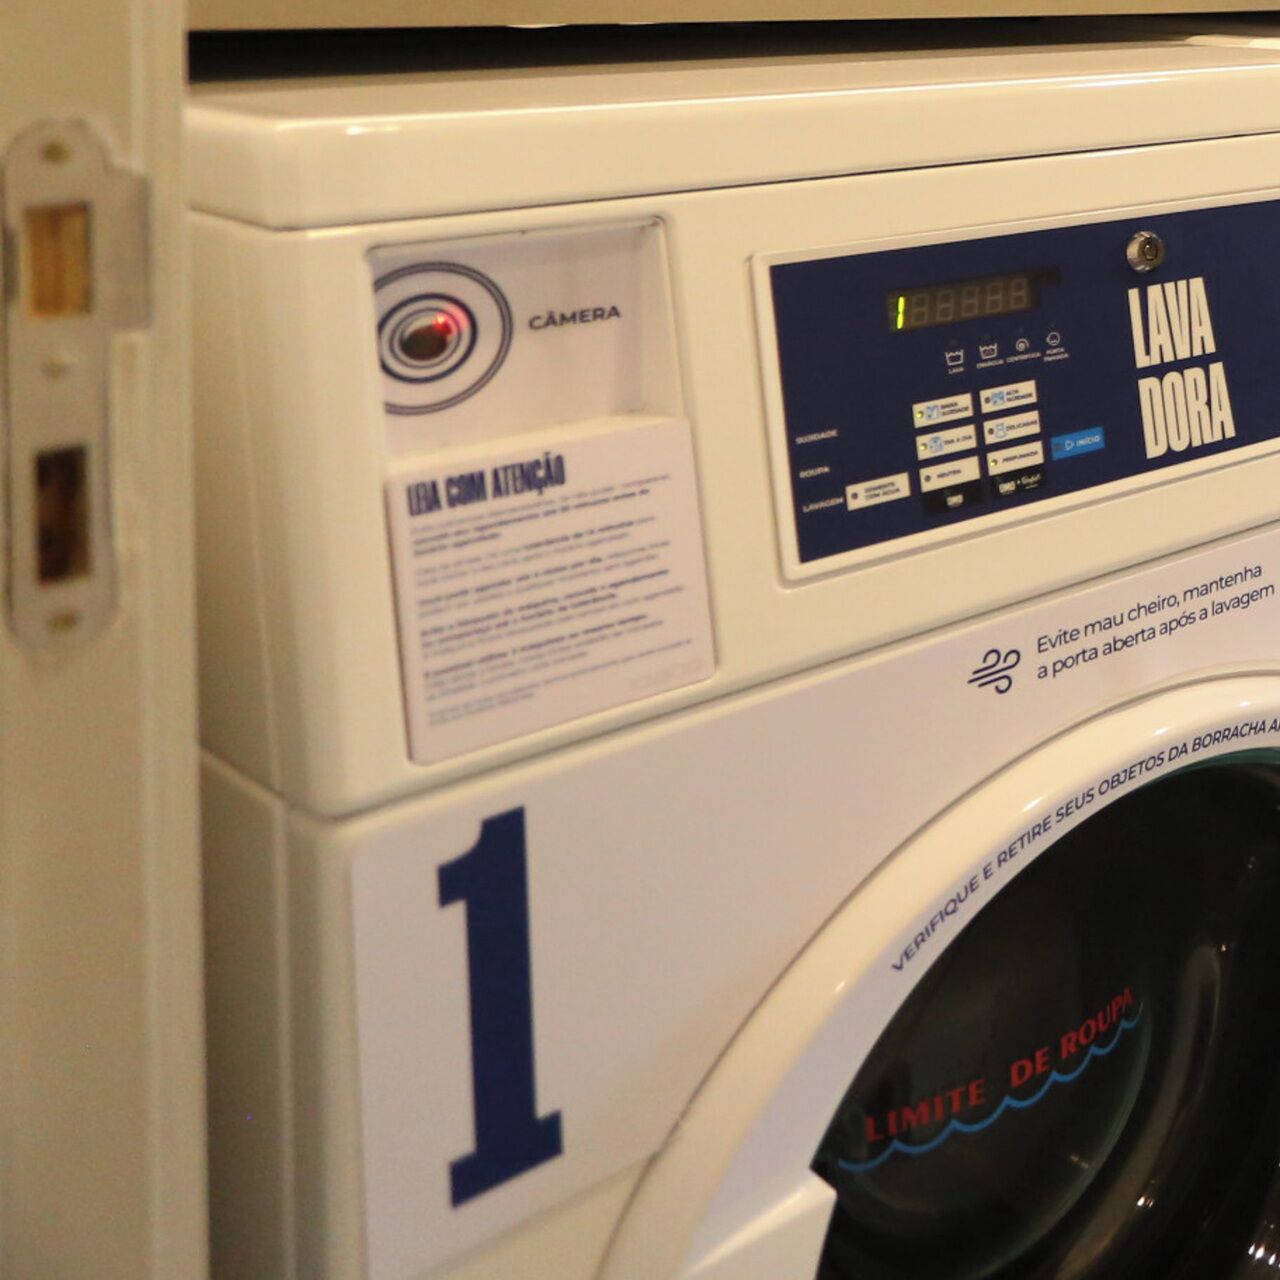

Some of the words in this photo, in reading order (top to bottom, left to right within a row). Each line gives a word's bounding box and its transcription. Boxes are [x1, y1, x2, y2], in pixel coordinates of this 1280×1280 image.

[529, 306, 621, 331] CÂMERA
[1128, 277, 1216, 369] LAVA
[1138, 362, 1236, 460] DORA
[407, 480, 441, 517] LEIA
[446, 470, 486, 508] COM
[492, 451, 566, 498] ATENÇÃO
[1037, 628, 1080, 654] Evite
[1083, 614, 1125, 638] mau
[1128, 593, 1181, 623] cheiro,
[1183, 565, 1263, 603] mantenha
[1038, 666, 1048, 680] a
[1052, 648, 1099, 678] porta
[1102, 627, 1156, 663] aberta
[1159, 611, 1197, 638] após
[1200, 608, 1209, 622] a
[1210, 583, 1275, 618] lavagem
[891, 876, 982, 973] VERIFIQUE
[982, 863, 996, 880] E
[997, 815, 1054, 869] RETIRE
[1054, 788, 1096, 825] SEUS
[1098, 751, 1166, 797] OBJETOS
[1167, 741, 1189, 763] DA
[1191, 718, 1267, 753] BORRACHA
[437, 805, 563, 1209] 1
[866, 1077, 988, 1143] LIMITE
[1009, 1046, 1052, 1089] DE
[1060, 986, 1135, 1062] ROUPA
